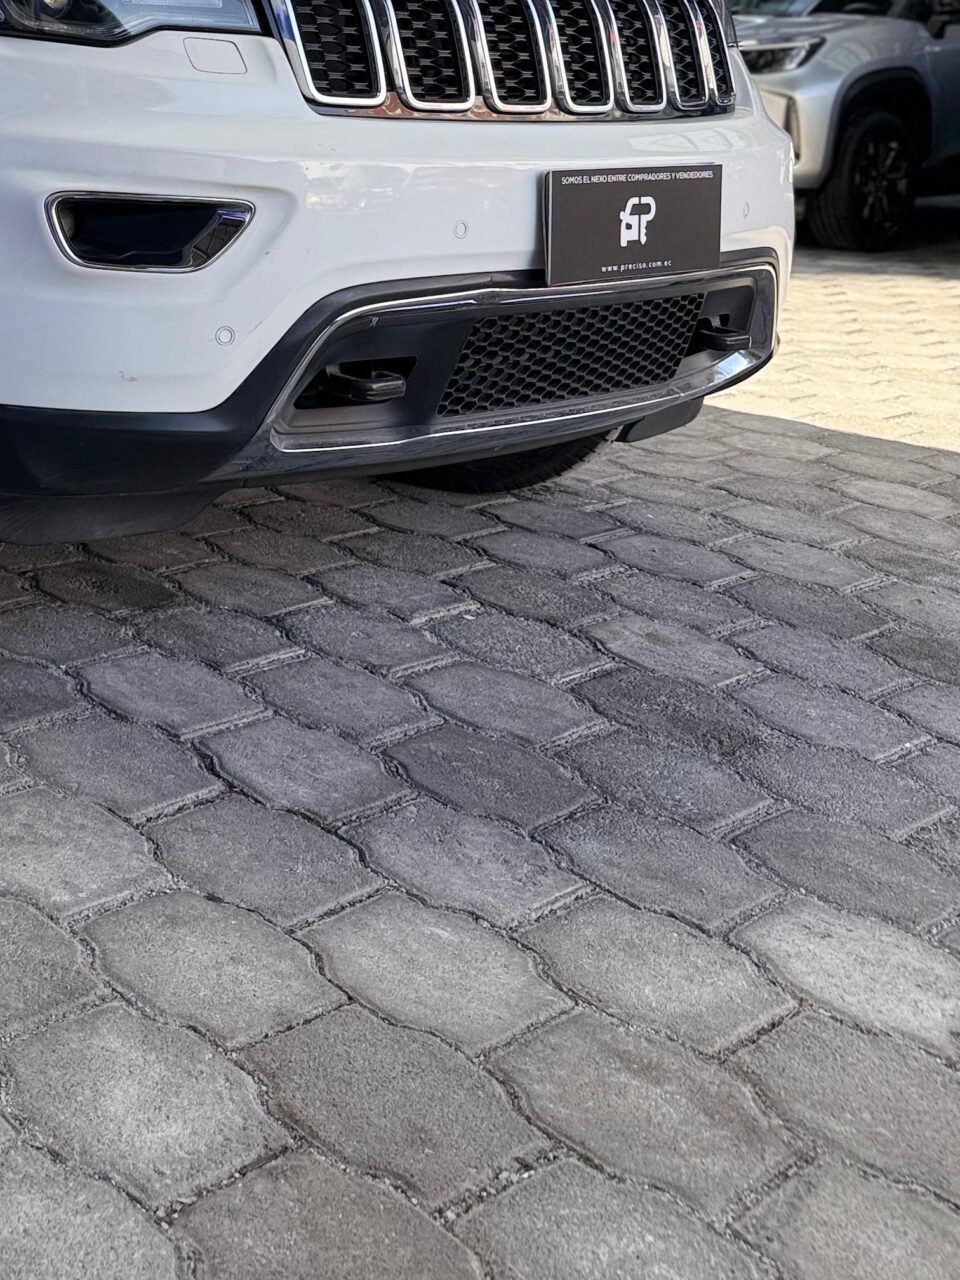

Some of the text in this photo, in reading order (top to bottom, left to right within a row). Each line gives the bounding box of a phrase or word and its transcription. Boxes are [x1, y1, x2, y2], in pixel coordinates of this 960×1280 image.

[561, 170, 714, 185] SOMOS EL NEXO ENTRE COMPRADORES Y VENDEDORES
[601, 260, 672, 272] www.preciso.com.ec
